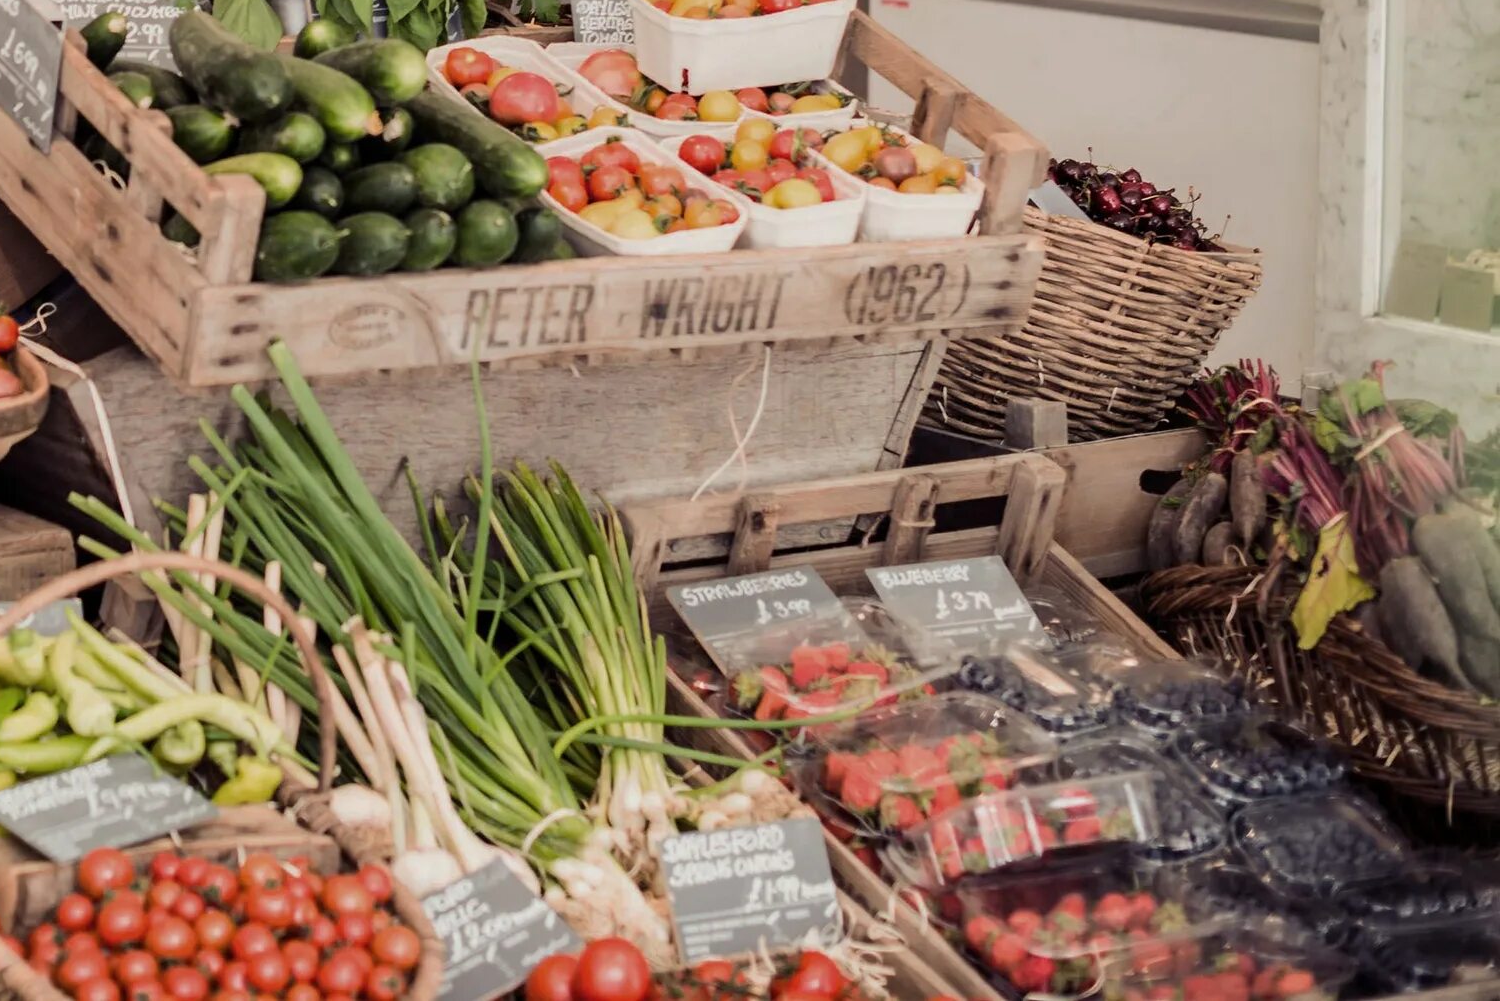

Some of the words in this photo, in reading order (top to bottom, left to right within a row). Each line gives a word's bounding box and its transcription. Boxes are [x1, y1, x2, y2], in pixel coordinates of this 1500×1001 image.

[458, 283, 596, 351] PETER
[637, 270, 794, 340] WRIGHT
[681, 570, 808, 607] STRAWBERRIES
[876, 563, 971, 590] BLUEBERRY
